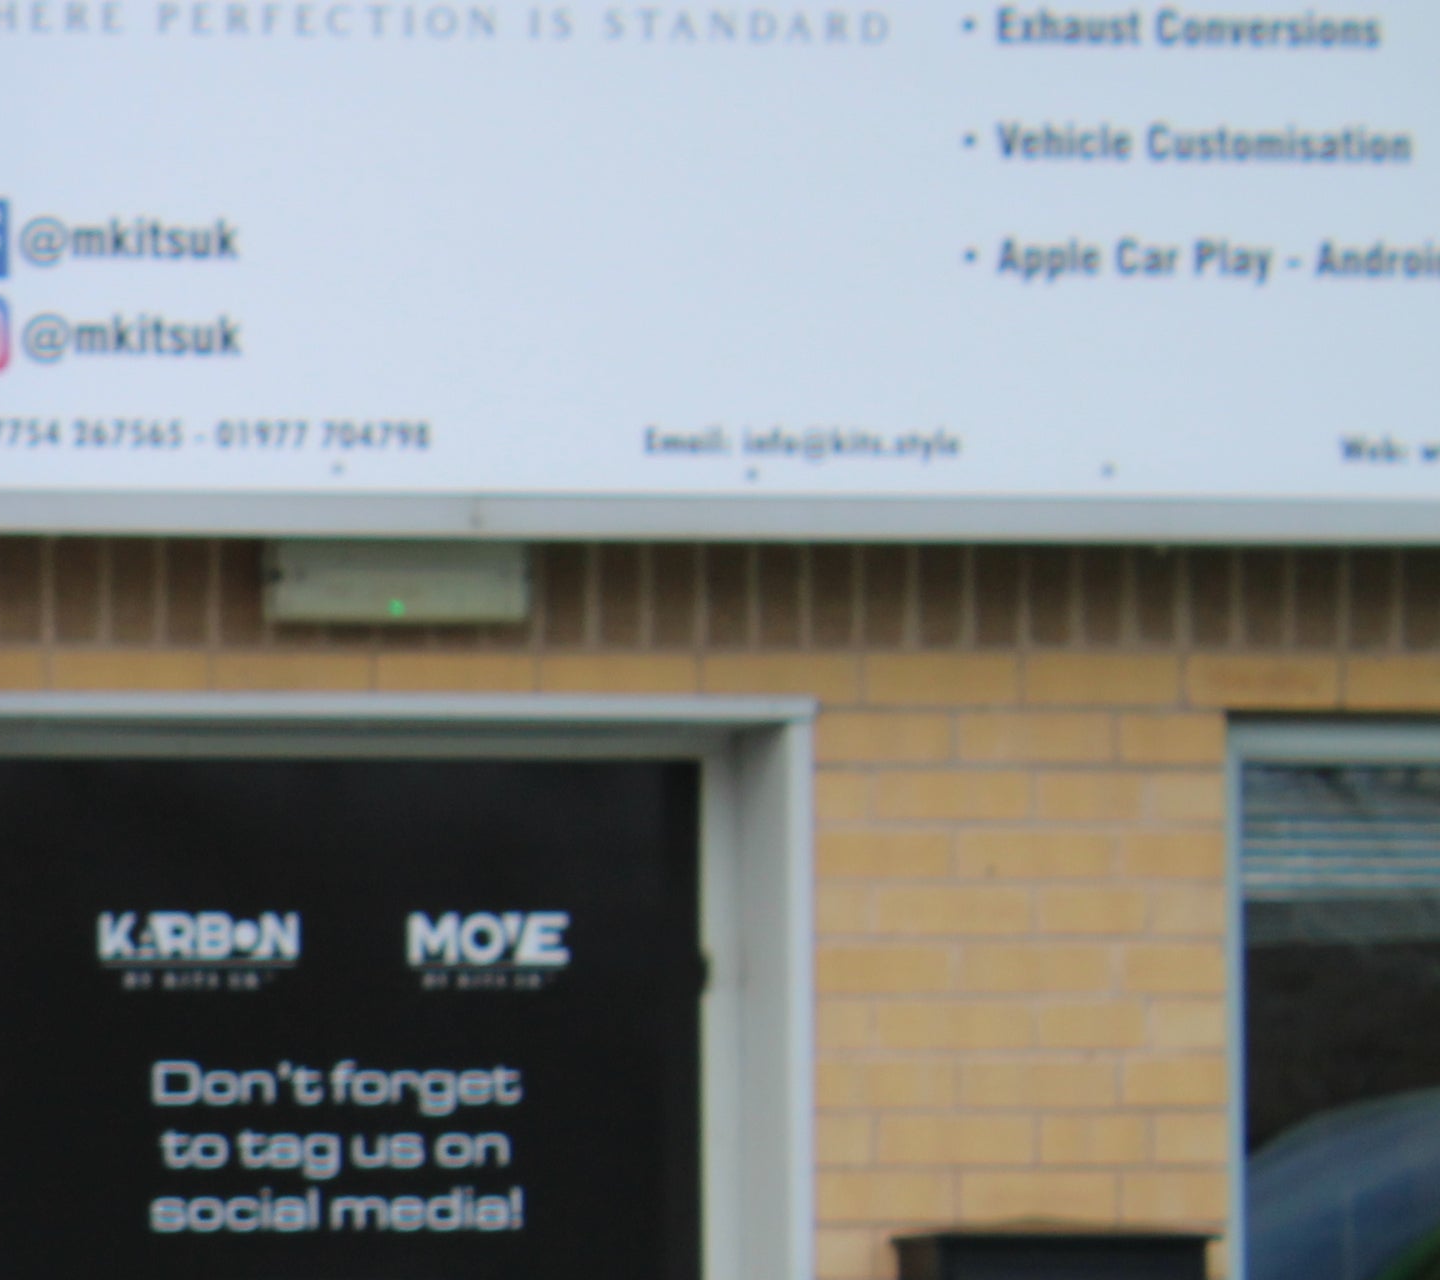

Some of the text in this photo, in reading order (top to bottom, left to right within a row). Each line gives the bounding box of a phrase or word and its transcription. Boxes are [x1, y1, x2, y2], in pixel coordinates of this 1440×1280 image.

[157, 2, 497, 38] PERFECTION
[529, 8, 574, 40] IS
[605, 8, 890, 44] STANDARD
[996, 7, 1382, 49] Exhaust Conversions
[997, 124, 1413, 164] Vehicle Customisation
[19, 216, 240, 268] @mkitsuk
[997, 237, 1101, 283] Apple
[1114, 237, 1179, 276] Car
[1193, 239, 1273, 285] Play
[1315, 240, 1440, 279] Androi
[21, 313, 243, 365] @mkitsuk
[215, 420, 309, 449] 01977
[152, 1060, 522, 1116] Don't forget
[161, 1131, 511, 1179] to tag us on
[150, 1188, 523, 1232] social media!
